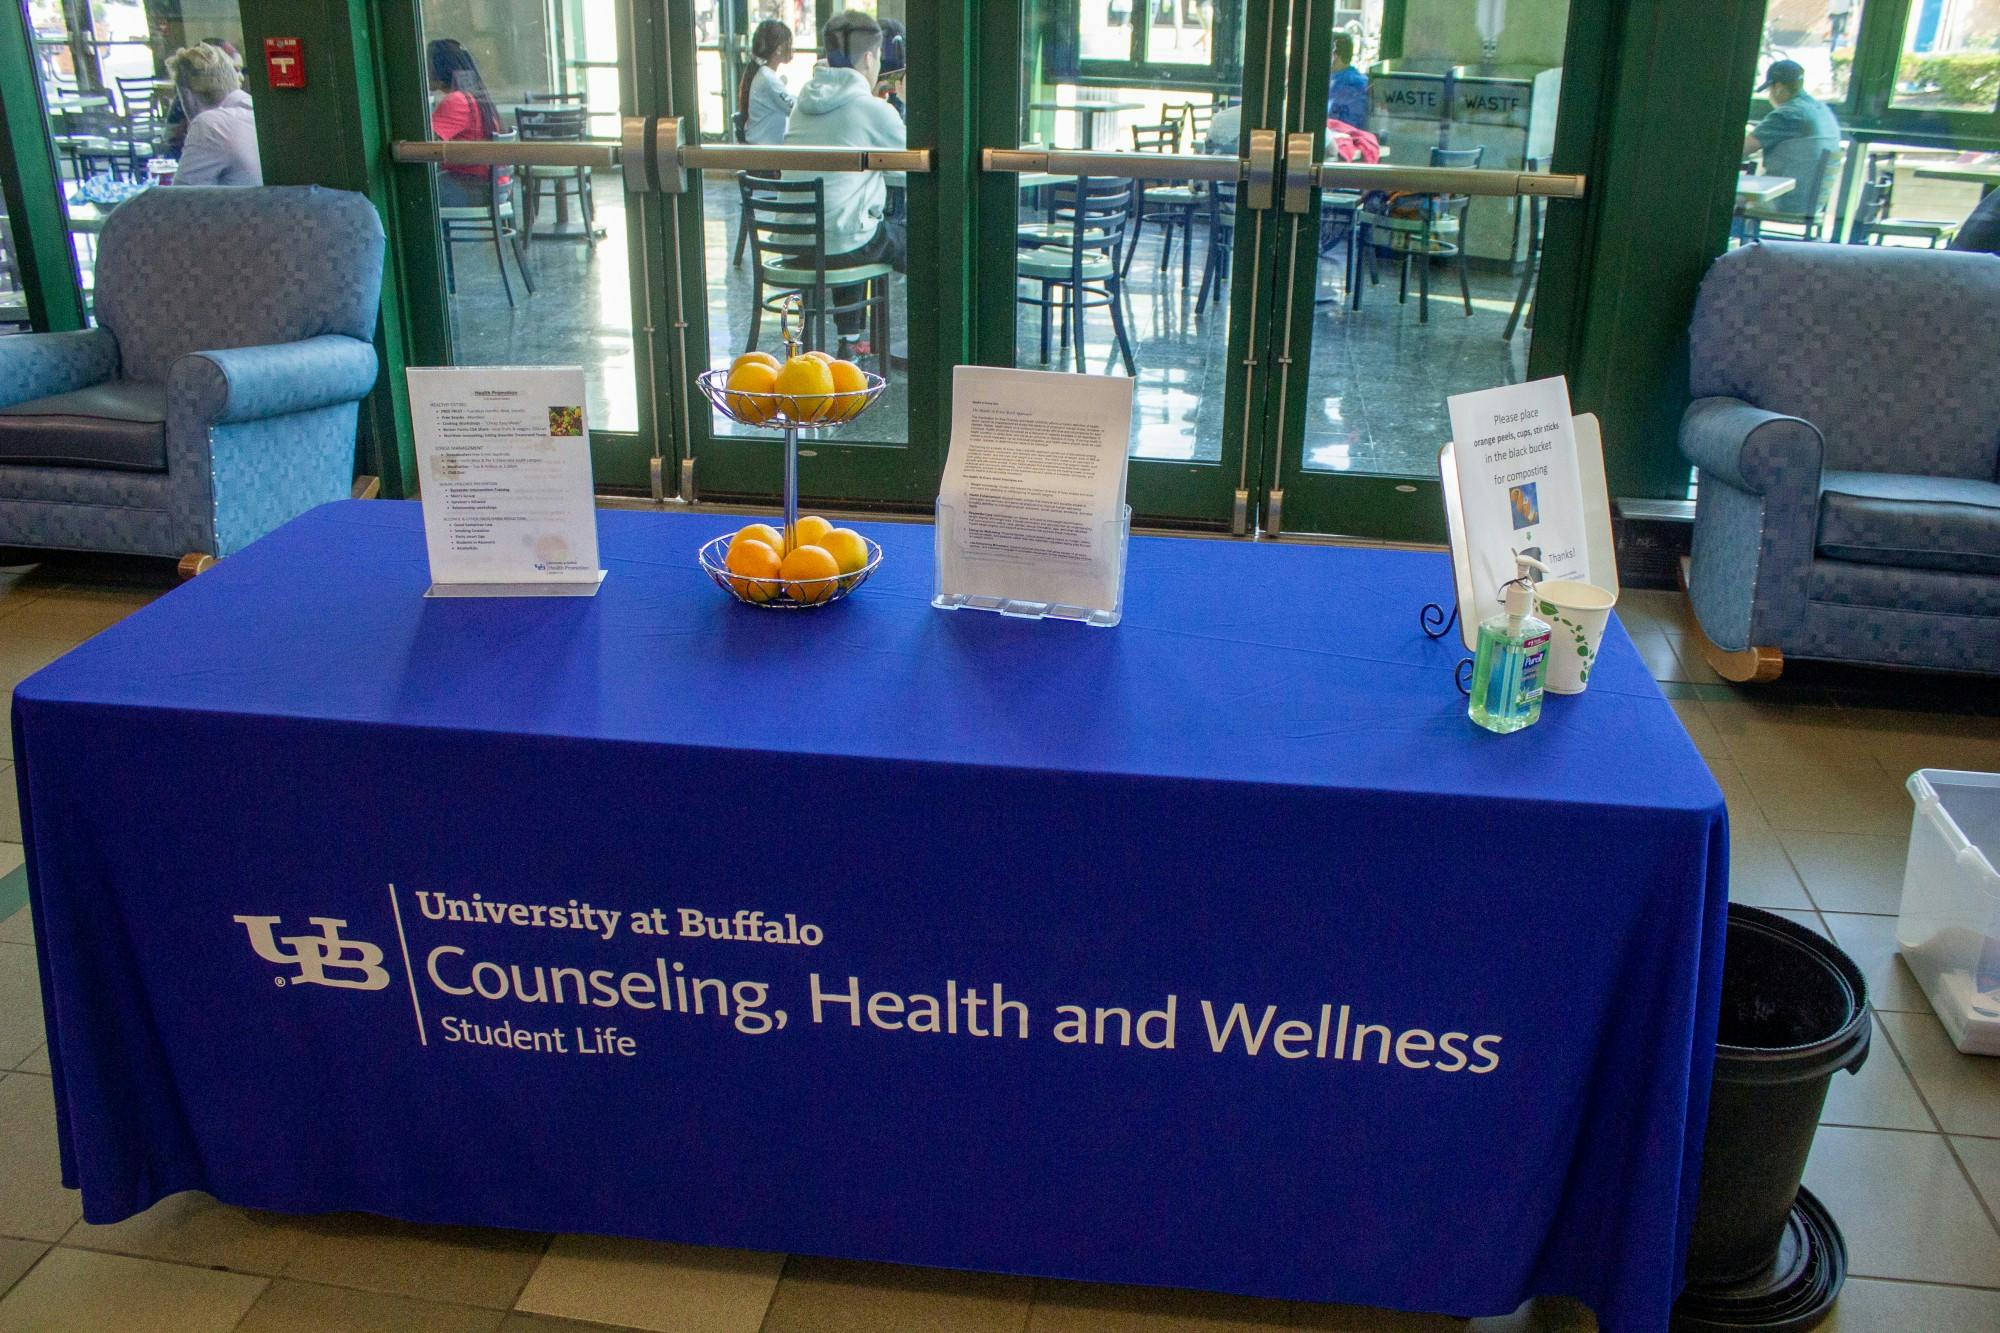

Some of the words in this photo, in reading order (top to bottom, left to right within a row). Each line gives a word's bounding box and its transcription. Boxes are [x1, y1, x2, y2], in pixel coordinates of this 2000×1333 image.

[1384, 90, 1437, 107] WASTE
[1494, 414, 1519, 426] Please
[1520, 409, 1539, 423] place
[1474, 435, 1496, 448] orange
[1497, 432, 1516, 444] peels,
[1517, 429, 1533, 440] cups,
[1533, 424, 1544, 435] stir
[1544, 421, 1560, 433] sticks
[1485, 453, 1492, 464] in
[1494, 450, 1507, 462] the
[1509, 446, 1527, 459] black
[1529, 440, 1552, 454] bucket
[1494, 473, 1505, 485] for
[1506, 464, 1549, 482] composting
[1548, 547, 1576, 565] Thanks!
[416, 891, 621, 939] University
[631, 909, 669, 935] at
[677, 908, 823, 945] Buffalo
[233, 915, 389, 990] UB
[428, 946, 787, 1034] Counseling,
[810, 973, 1028, 1038] Health
[1054, 995, 1176, 1049] and
[1201, 1000, 1502, 1073] Wellness
[442, 1017, 568, 1053] Student
[577, 1028, 637, 1056] Life
